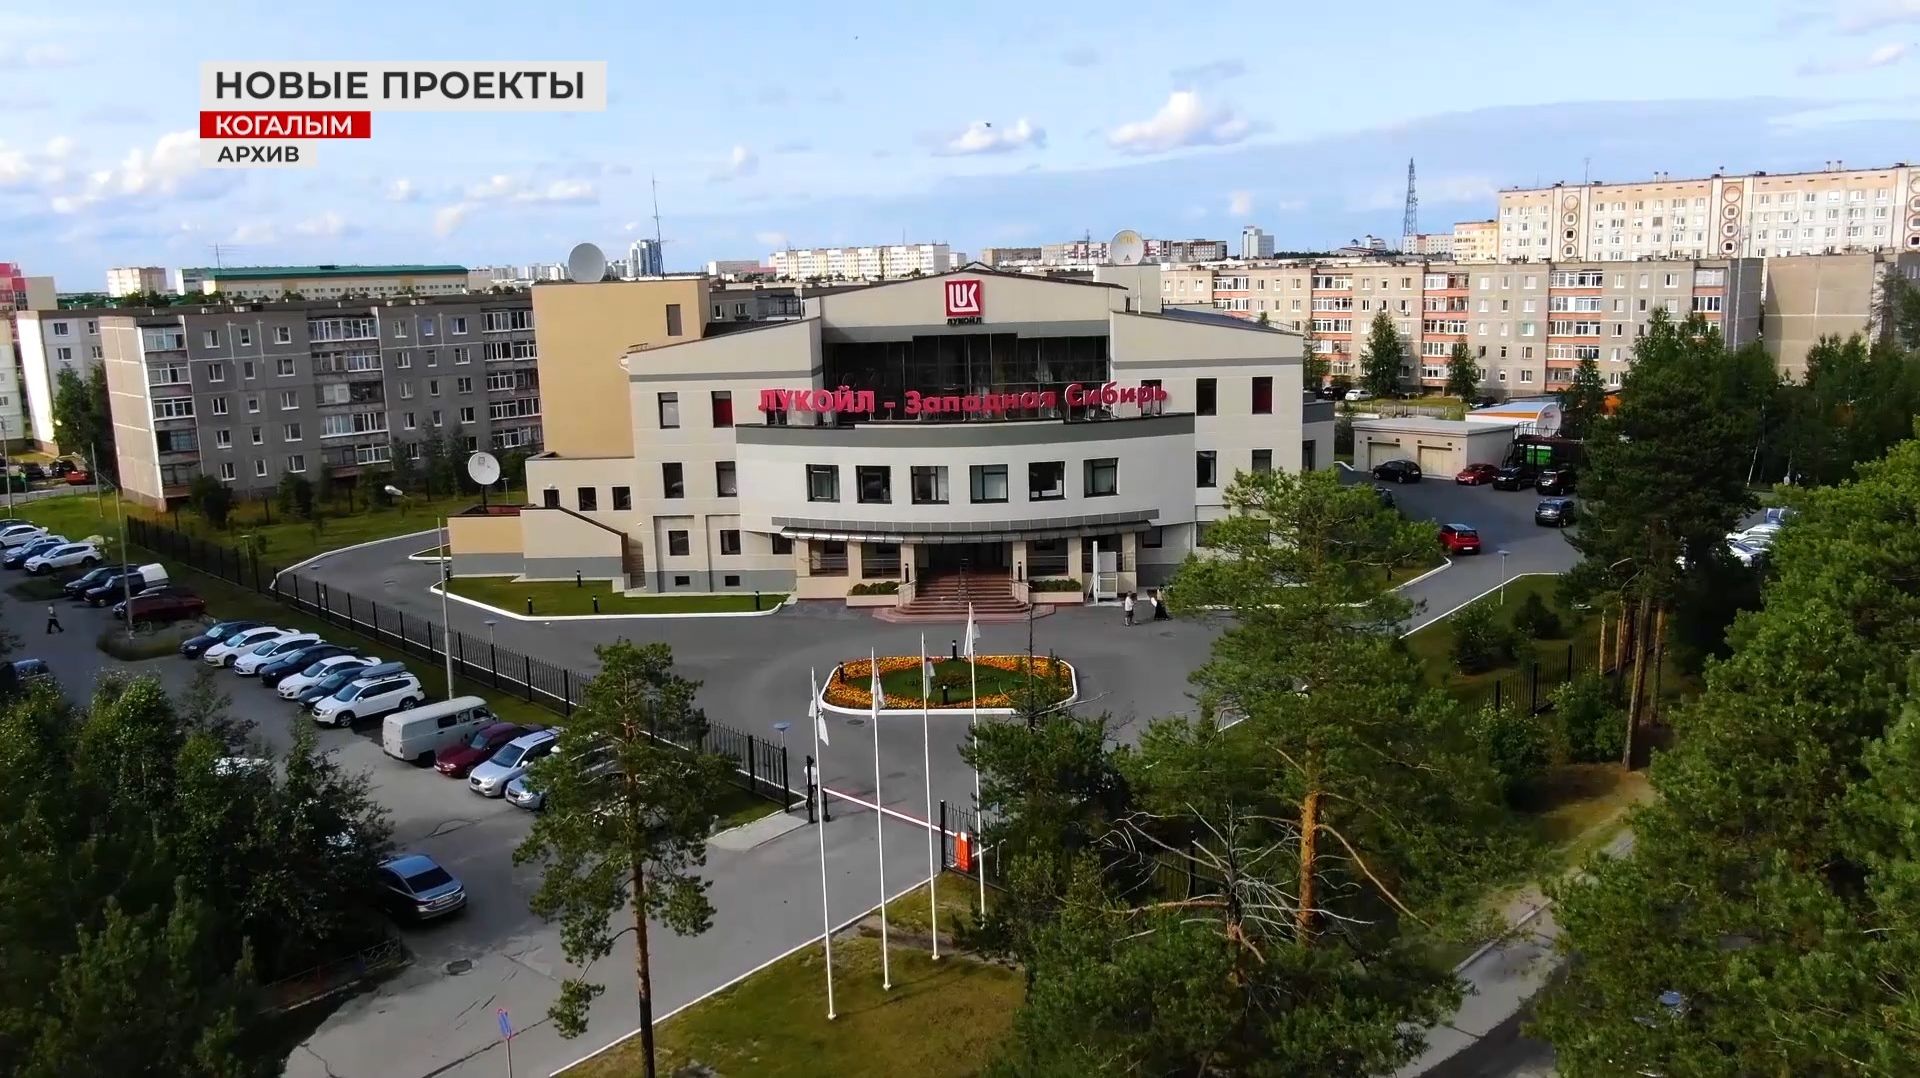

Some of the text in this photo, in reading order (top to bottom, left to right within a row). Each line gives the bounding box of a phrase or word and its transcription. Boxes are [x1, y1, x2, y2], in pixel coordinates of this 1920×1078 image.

[947, 317, 983, 326] ЛУКОЙЛ
[758, 385, 875, 413] ЛУКОЙЛ
[905, 390, 1057, 414] Западная
[1064, 381, 1167, 408] Сибирь
